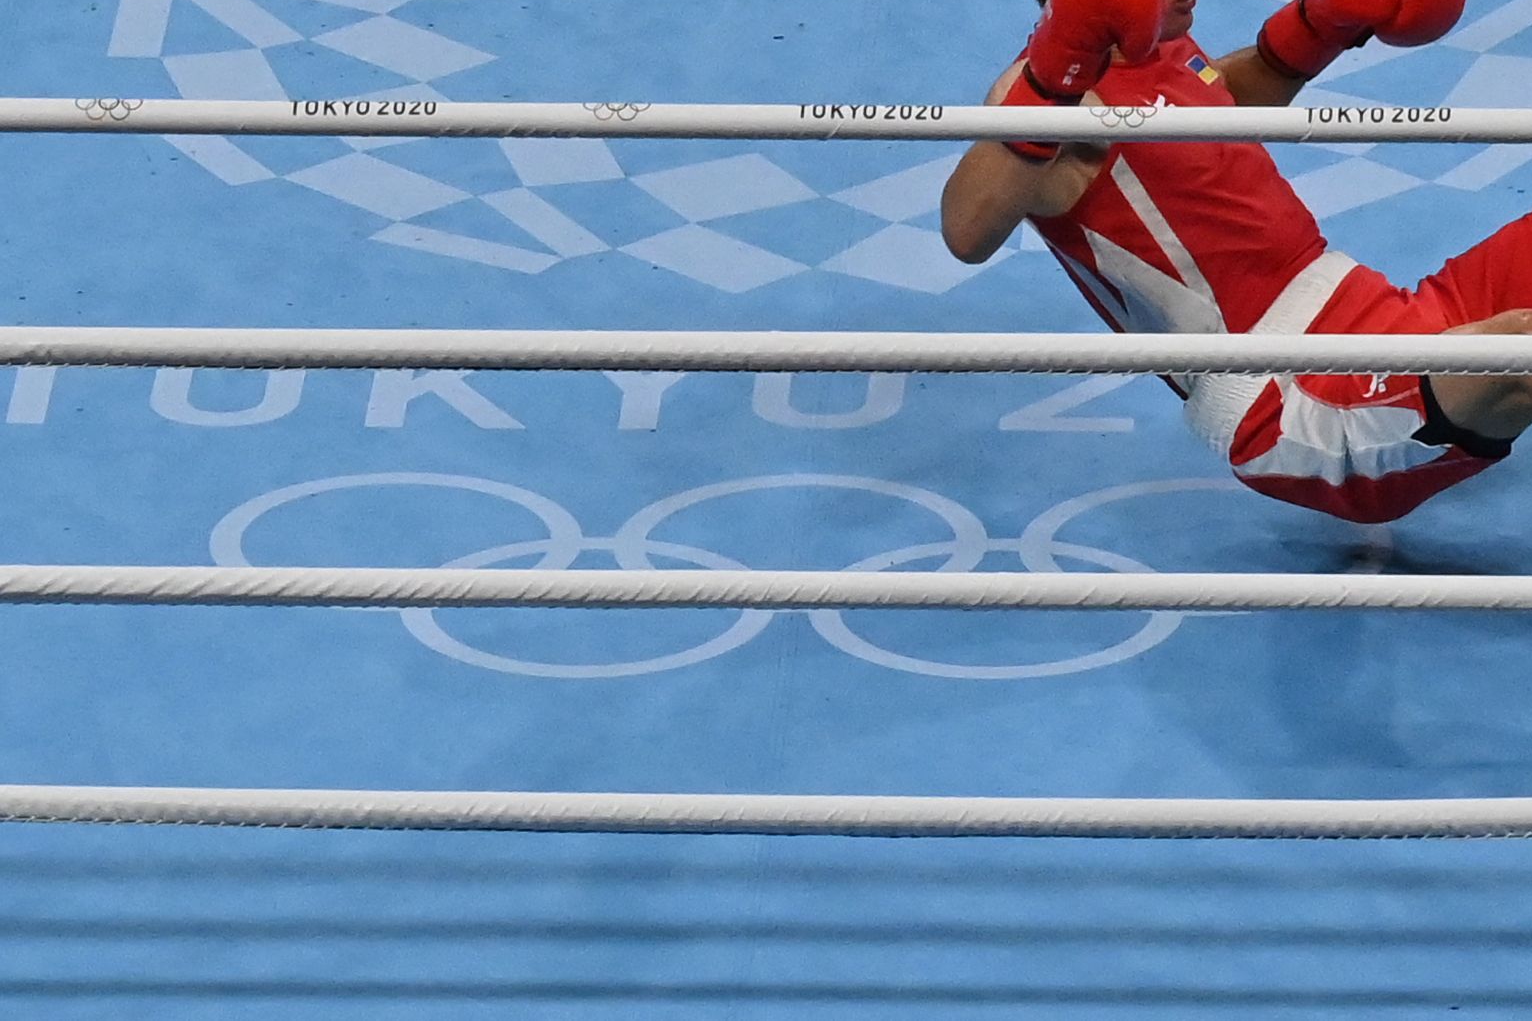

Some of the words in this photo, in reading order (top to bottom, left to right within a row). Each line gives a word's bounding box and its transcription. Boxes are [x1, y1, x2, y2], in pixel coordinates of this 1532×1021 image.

[376, 101, 438, 116] 2020
[883, 105, 944, 121] 2020
[1304, 107, 1385, 124] TOKYO
[1391, 107, 1452, 123] 2020
